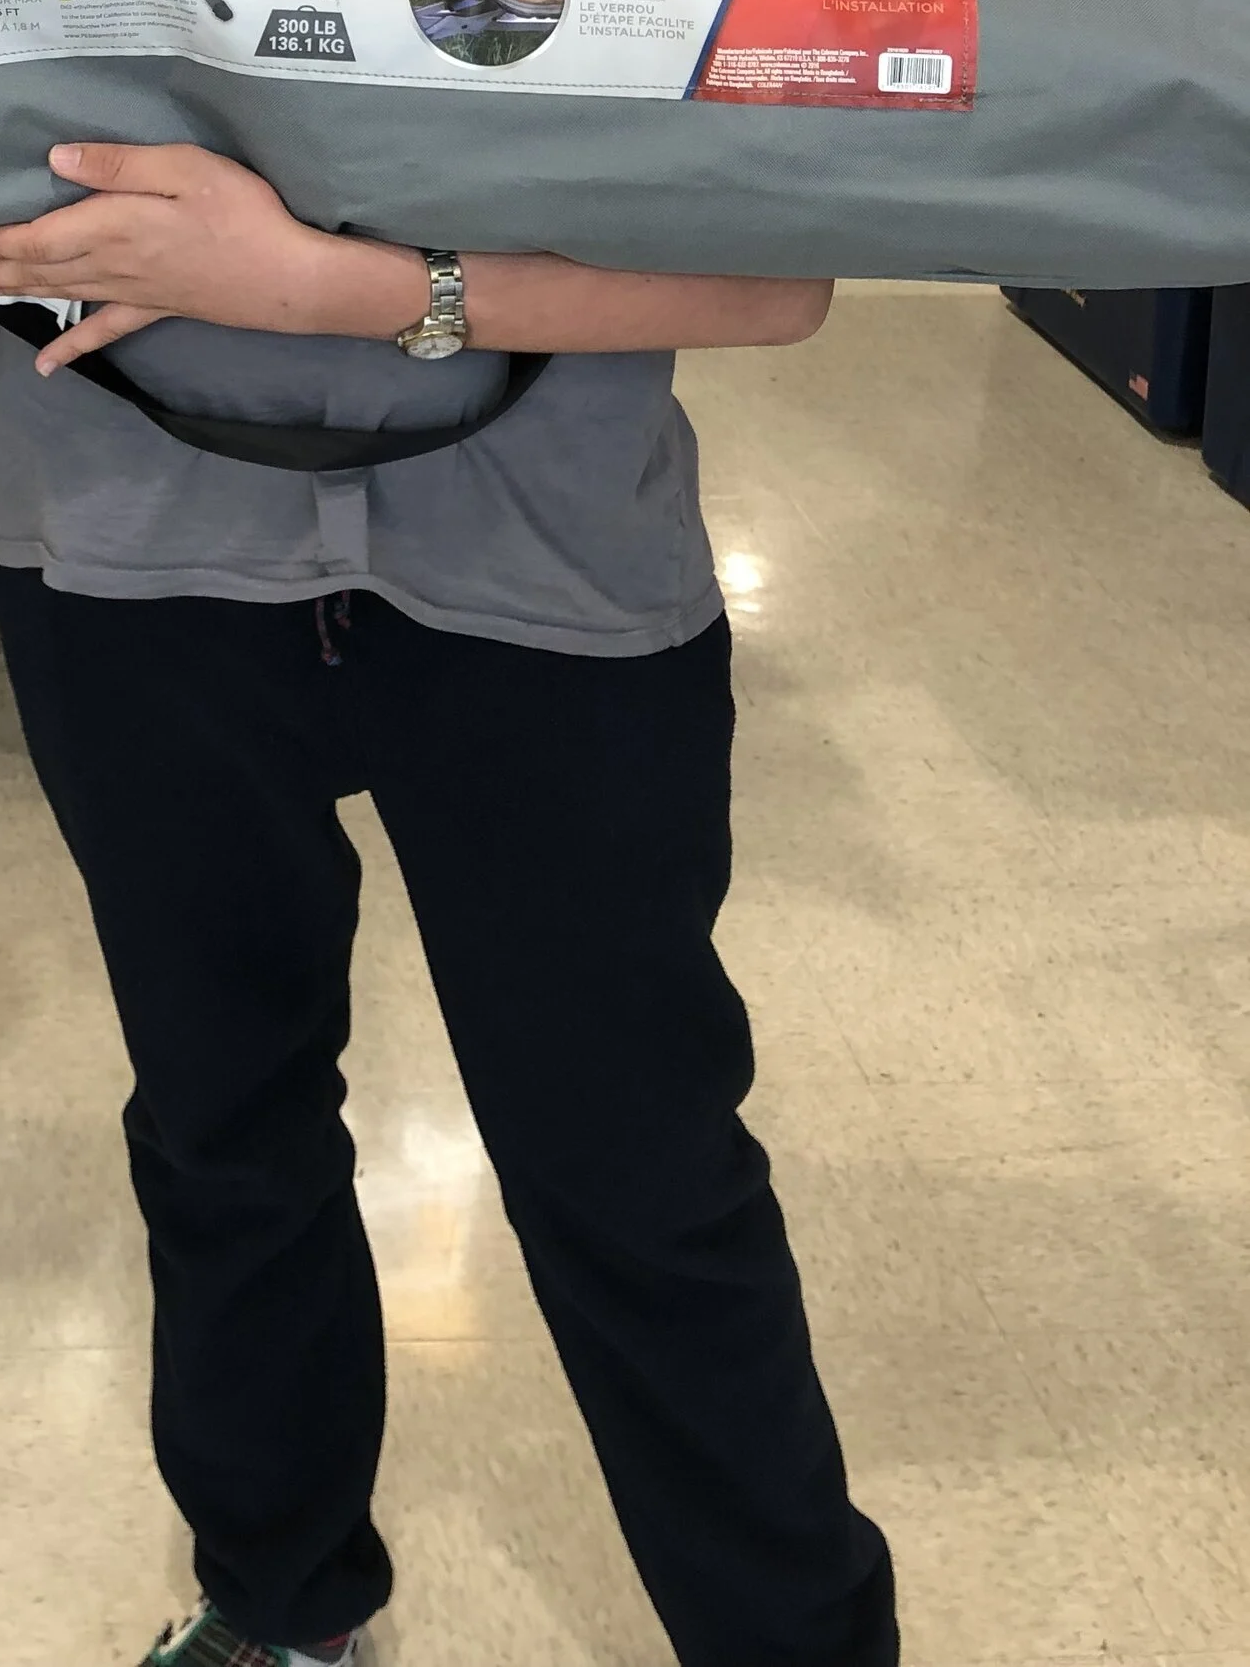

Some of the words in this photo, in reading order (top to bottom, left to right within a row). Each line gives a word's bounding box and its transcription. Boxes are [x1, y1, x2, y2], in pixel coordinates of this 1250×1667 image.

[5, 7, 20, 16] FT
[579, 1, 595, 12] LE
[599, 3, 655, 14] VERROU
[822, 0, 944, 14] L'INSTALLATION
[13, 22, 28, 32] 1,8
[31, 22, 41, 31] M
[277, 19, 309, 34] 300
[314, 20, 337, 35] LB
[580, 12, 634, 26] D'ÉTAPE
[638, 16, 695, 30] FACILITE
[579, 26, 686, 40] L'INSTALLATION
[268, 36, 313, 52] 136.1
[318, 38, 346, 54] KG
